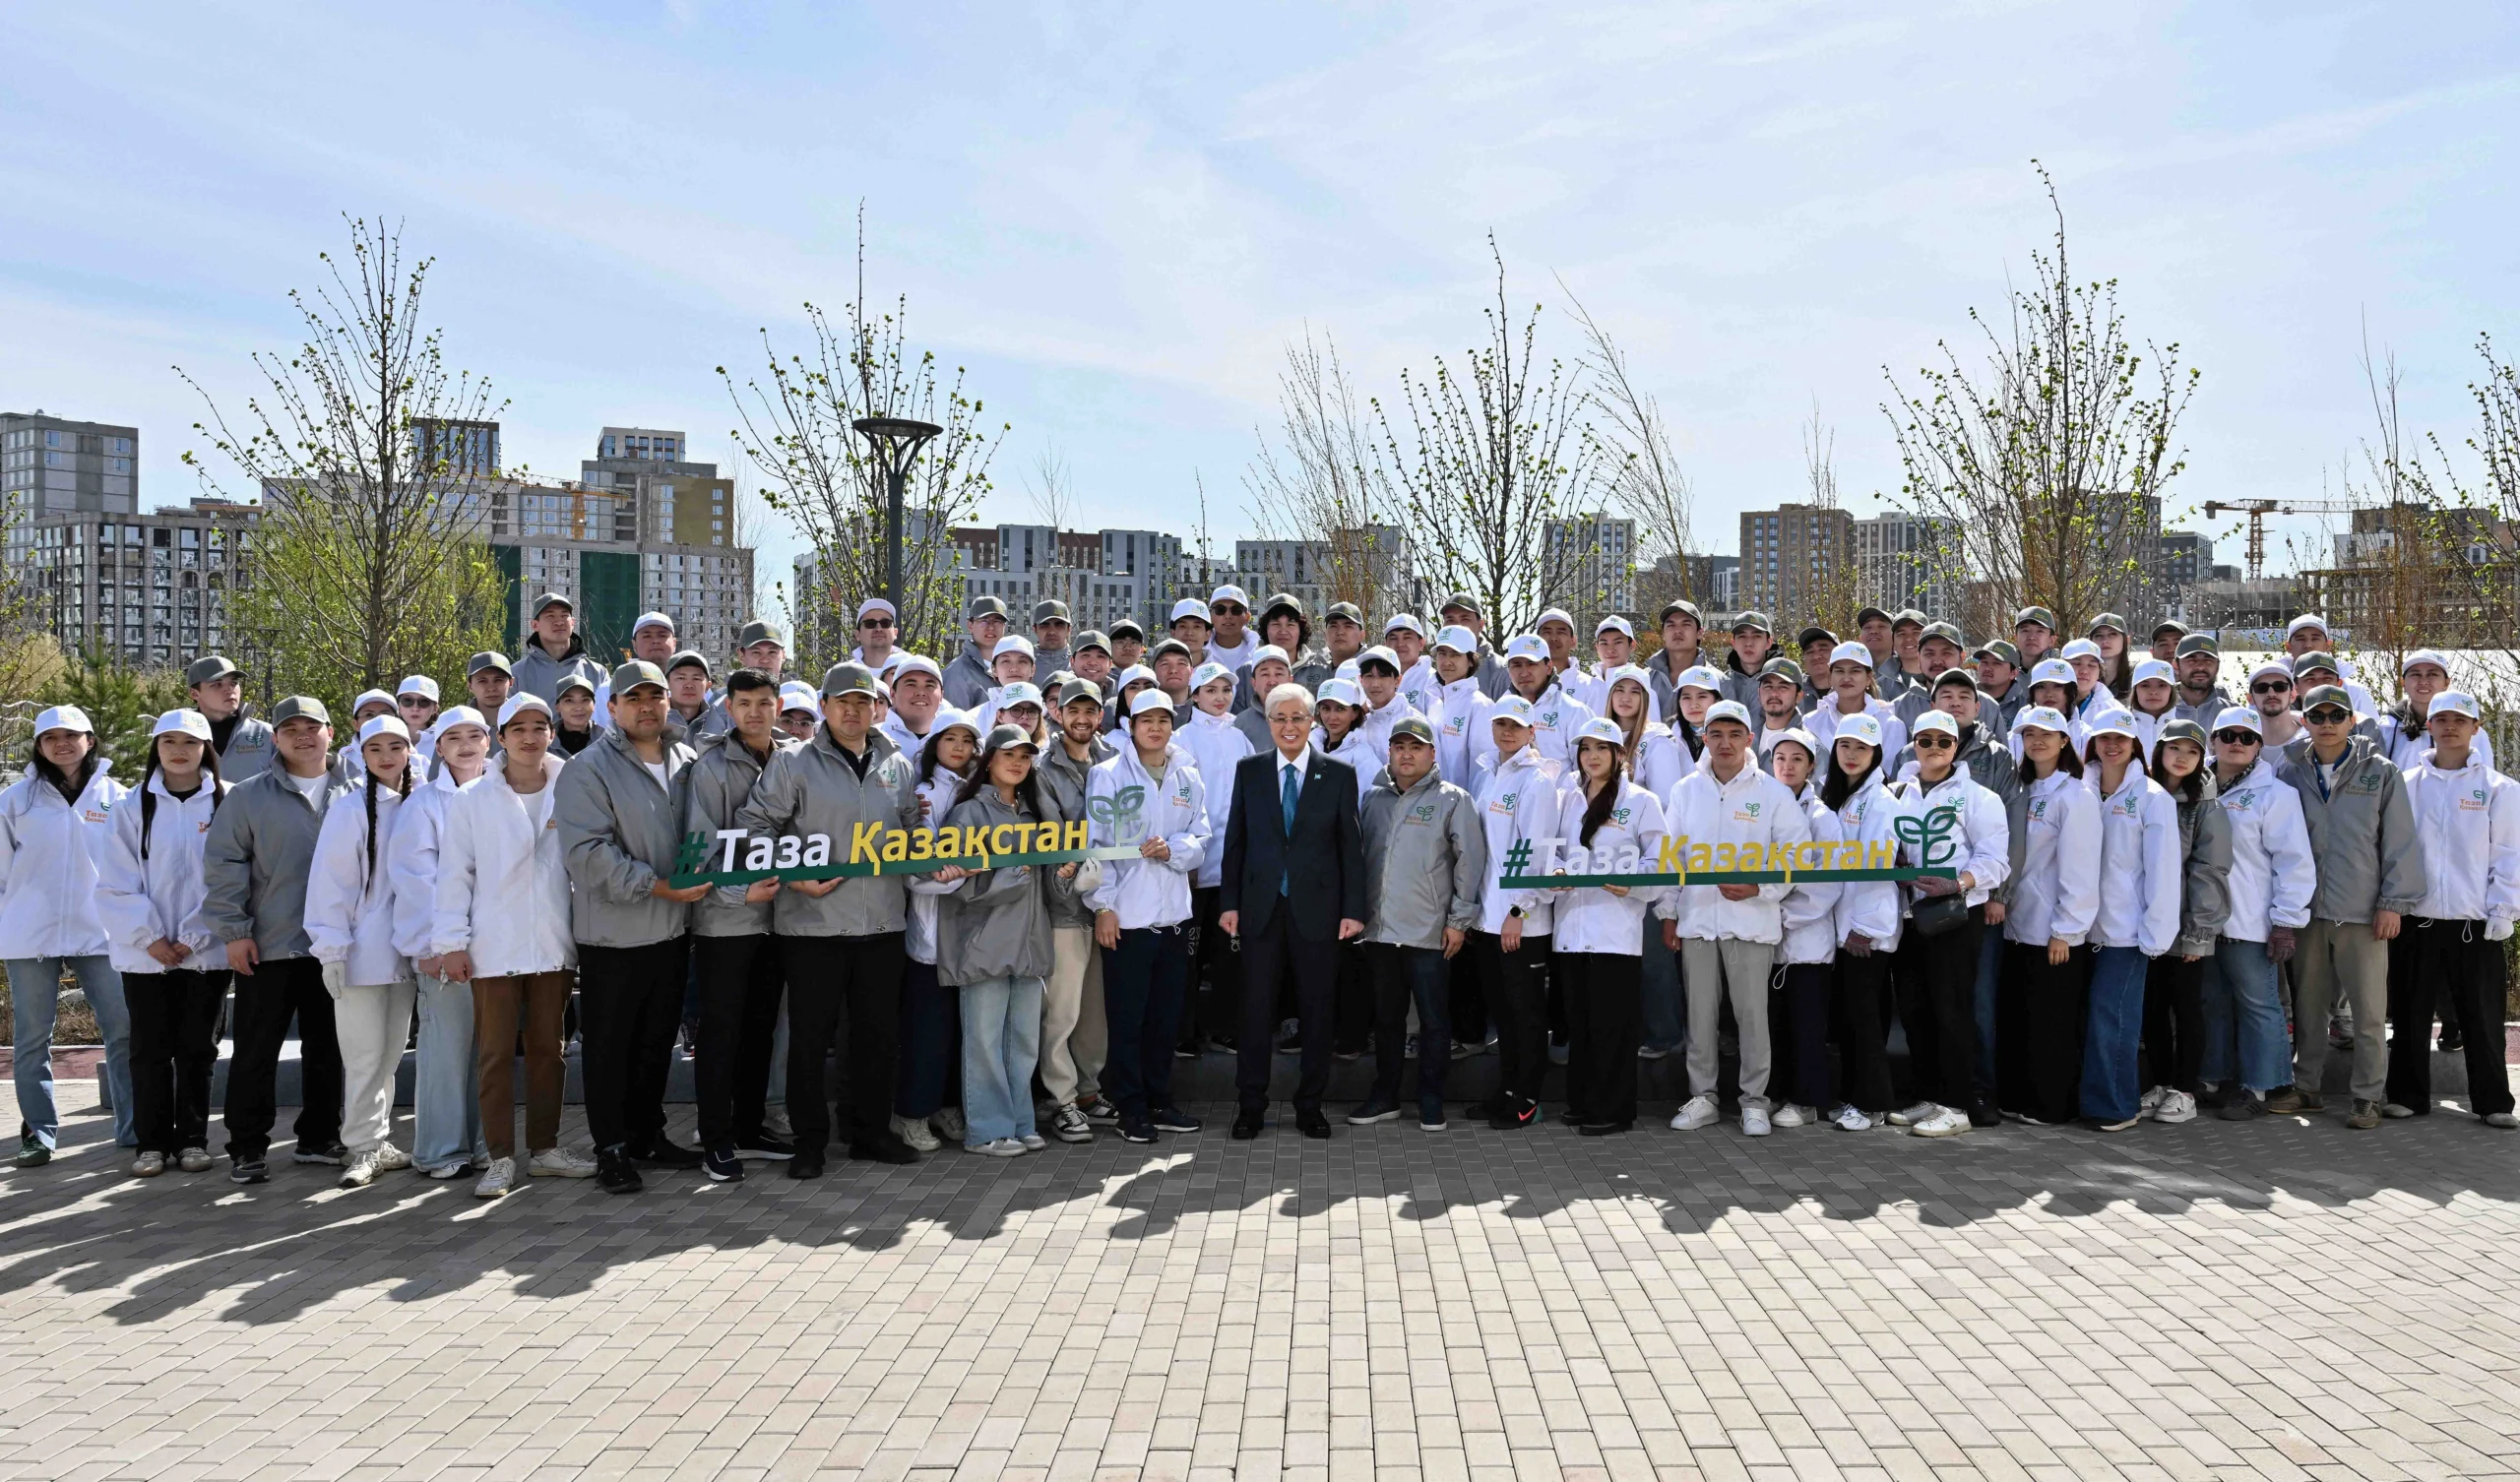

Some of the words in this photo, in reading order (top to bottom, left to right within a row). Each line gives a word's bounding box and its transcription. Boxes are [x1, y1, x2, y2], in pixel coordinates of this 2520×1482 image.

[1490, 801, 1505, 810] Таза
[674, 829, 831, 875] #Таза
[850, 820, 1089, 876] Қазақстан
[1503, 837, 1641, 878] #Таза
[1658, 835, 1894, 886] Қазақстан
